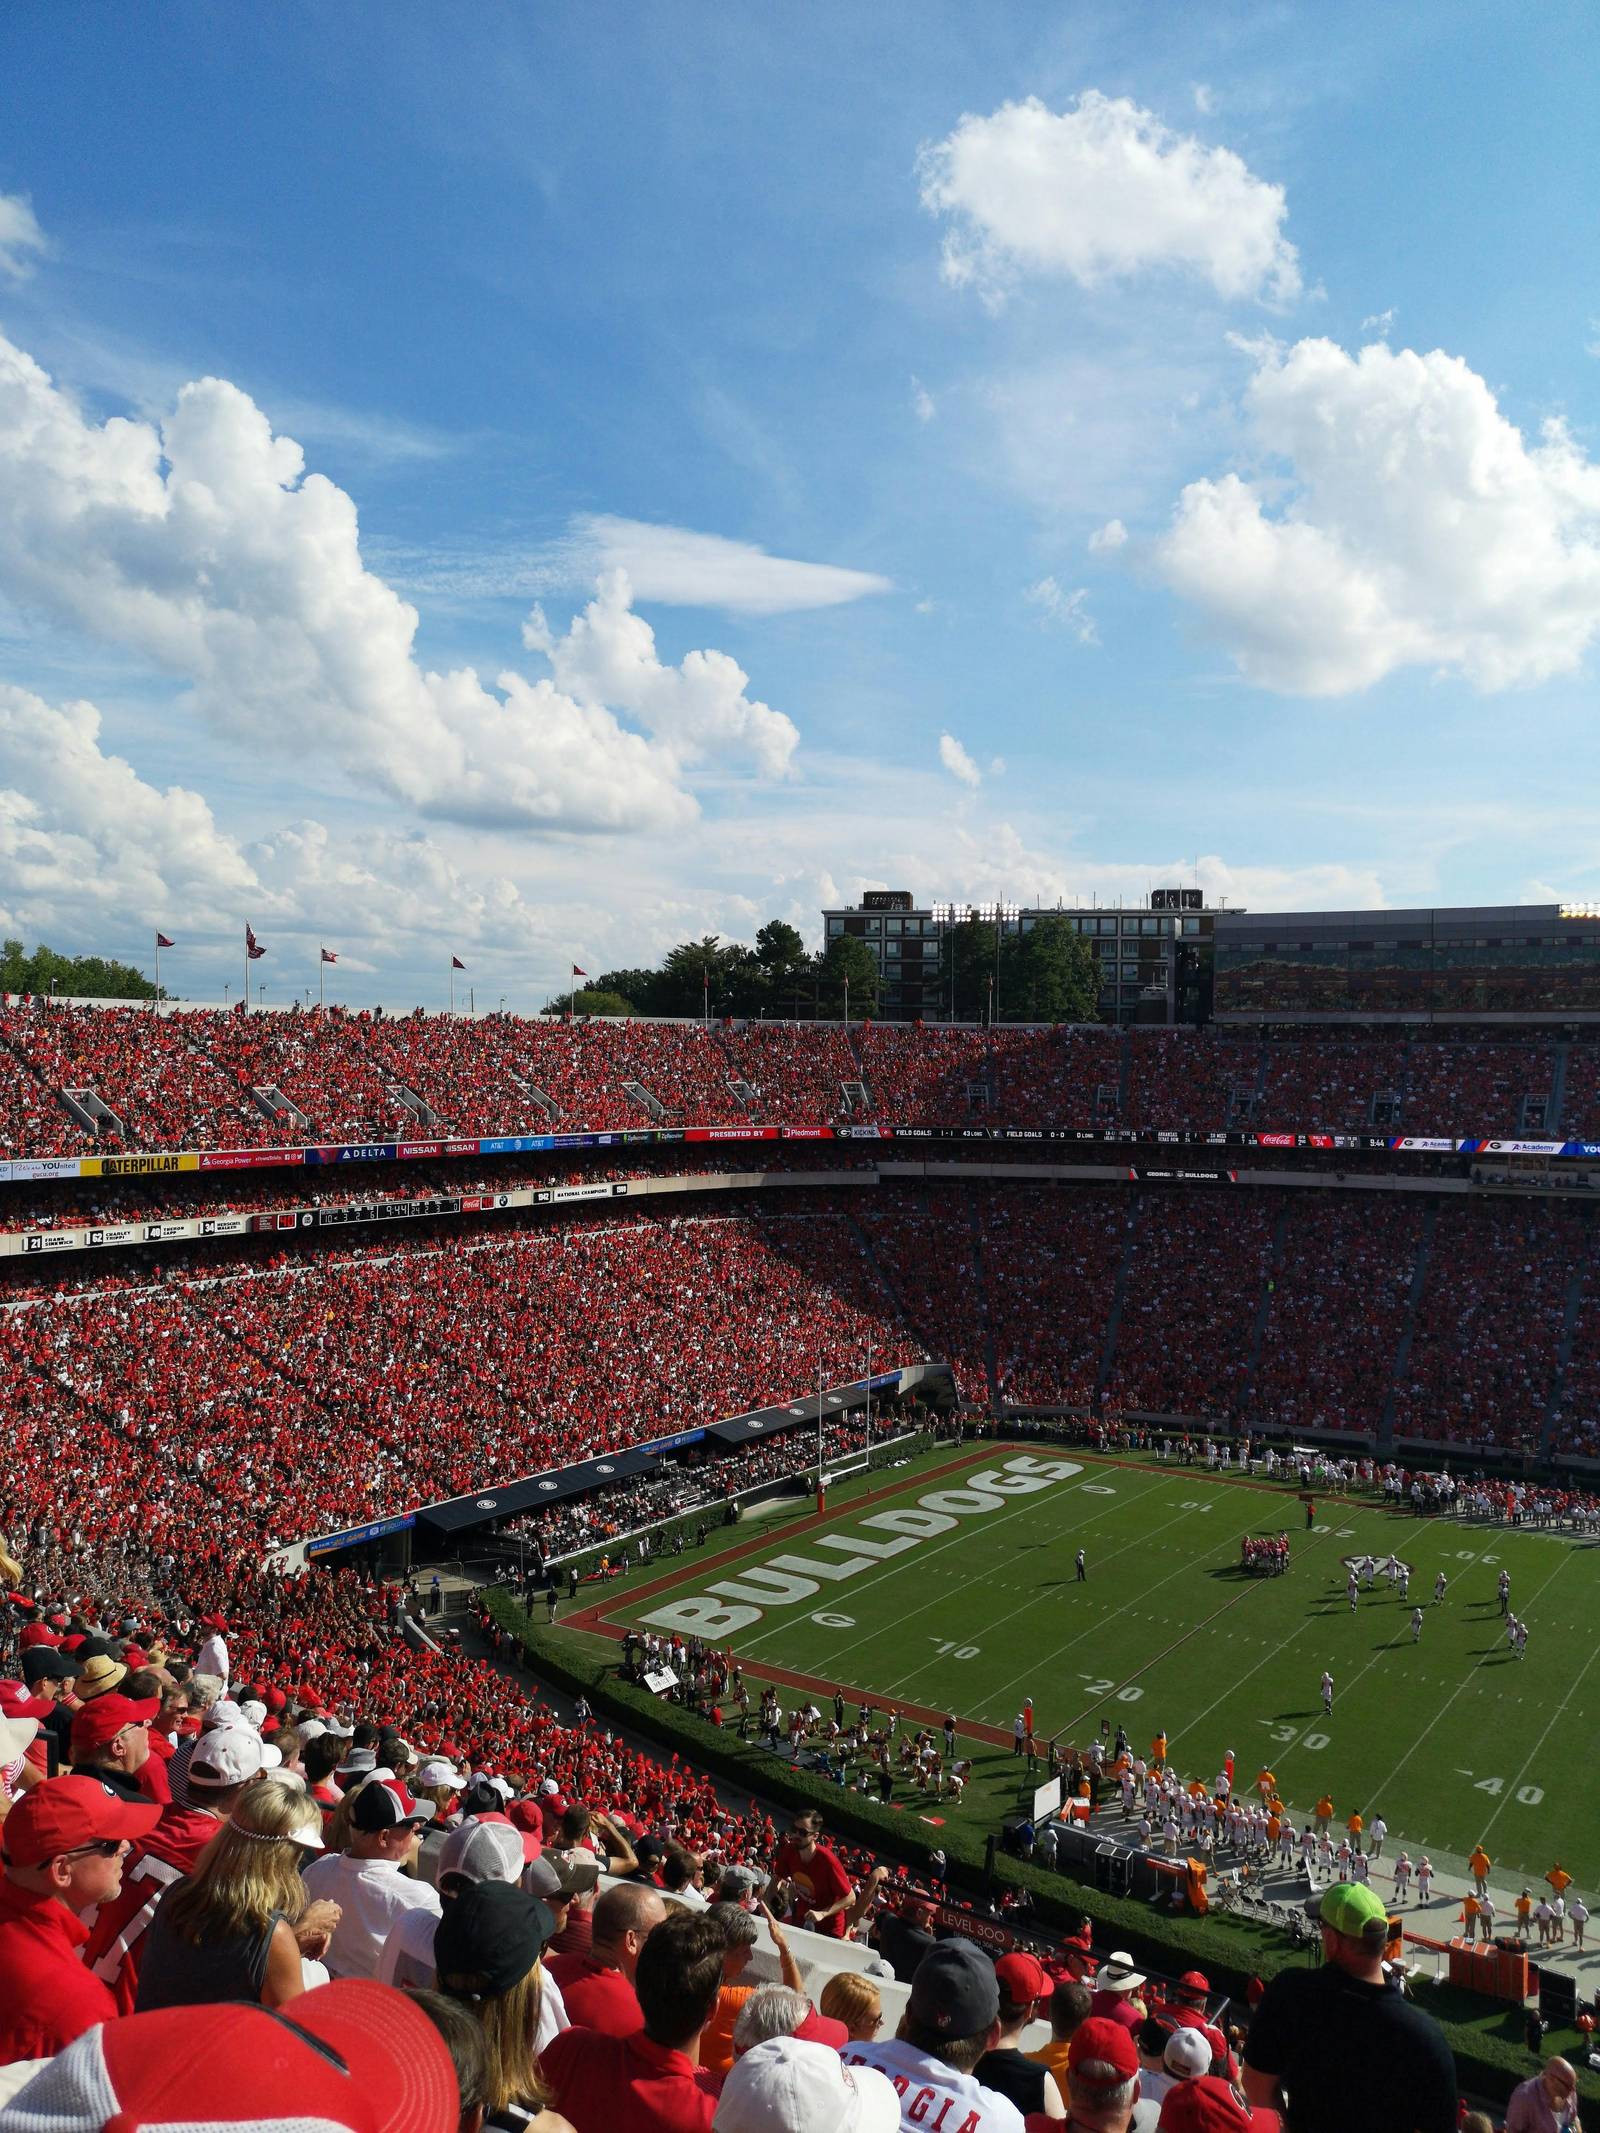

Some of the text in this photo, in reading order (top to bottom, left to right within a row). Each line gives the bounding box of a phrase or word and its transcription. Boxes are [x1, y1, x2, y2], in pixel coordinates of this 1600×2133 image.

[709, 1130, 751, 1138] PRESENTED
[531, 1139, 545, 1148] AT&T
[1370, 1139, 1385, 1147] 9:44
[1521, 1143, 1555, 1152] Academy
[353, 1148, 386, 1158] DELTA
[403, 1146, 437, 1155] NISSAN
[211, 1158, 234, 1167] Georgia
[581, 1188, 608, 1196] CHAMPIONS
[386, 1205, 407, 1216] 9:44
[410, 1206, 420, 1215] 24
[325, 1214, 333, 1223] 10
[150, 1227, 161, 1237] 40
[205, 1223, 214, 1231] 34
[92, 1232, 103, 1243] 62
[30, 1238, 41, 1249] 21
[635, 1456, 1085, 1641] BULLDOGS
[935, 1641, 981, 1660] 10
[1084, 1679, 1145, 1702] 20
[1269, 1725, 1332, 1750] 30
[1473, 1776, 1545, 1805] 40
[942, 1909, 1006, 1943] LEVEL 300
